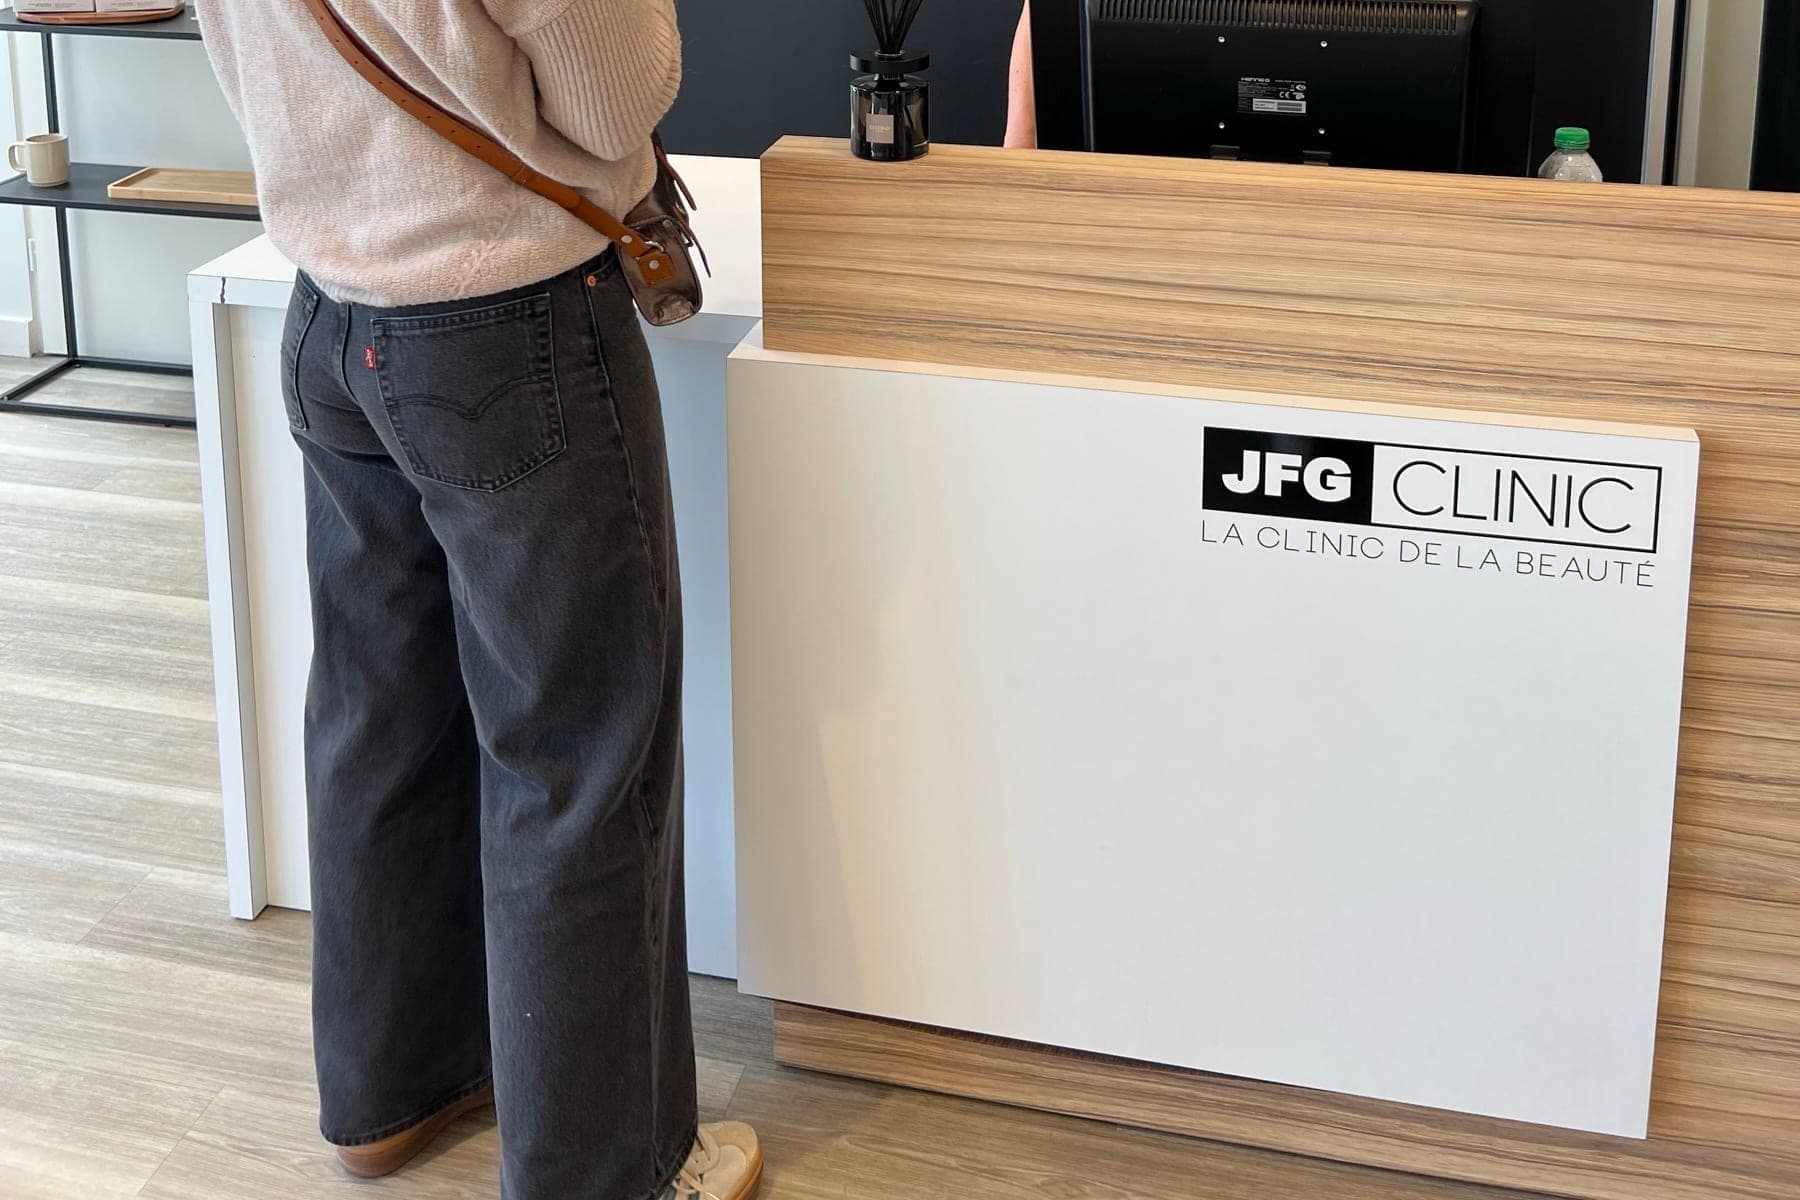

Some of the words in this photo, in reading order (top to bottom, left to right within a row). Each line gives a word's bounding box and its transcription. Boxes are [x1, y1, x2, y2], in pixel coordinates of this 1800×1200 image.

[1222, 450, 1352, 502] JFG
[1393, 460, 1634, 534] CLINIC
[1201, 519, 1244, 546] LA
[1257, 526, 1385, 560] CLINIC
[1399, 539, 1442, 566] DE
[1457, 545, 1502, 572] LA
[1516, 551, 1657, 588] BEAUTÉ
